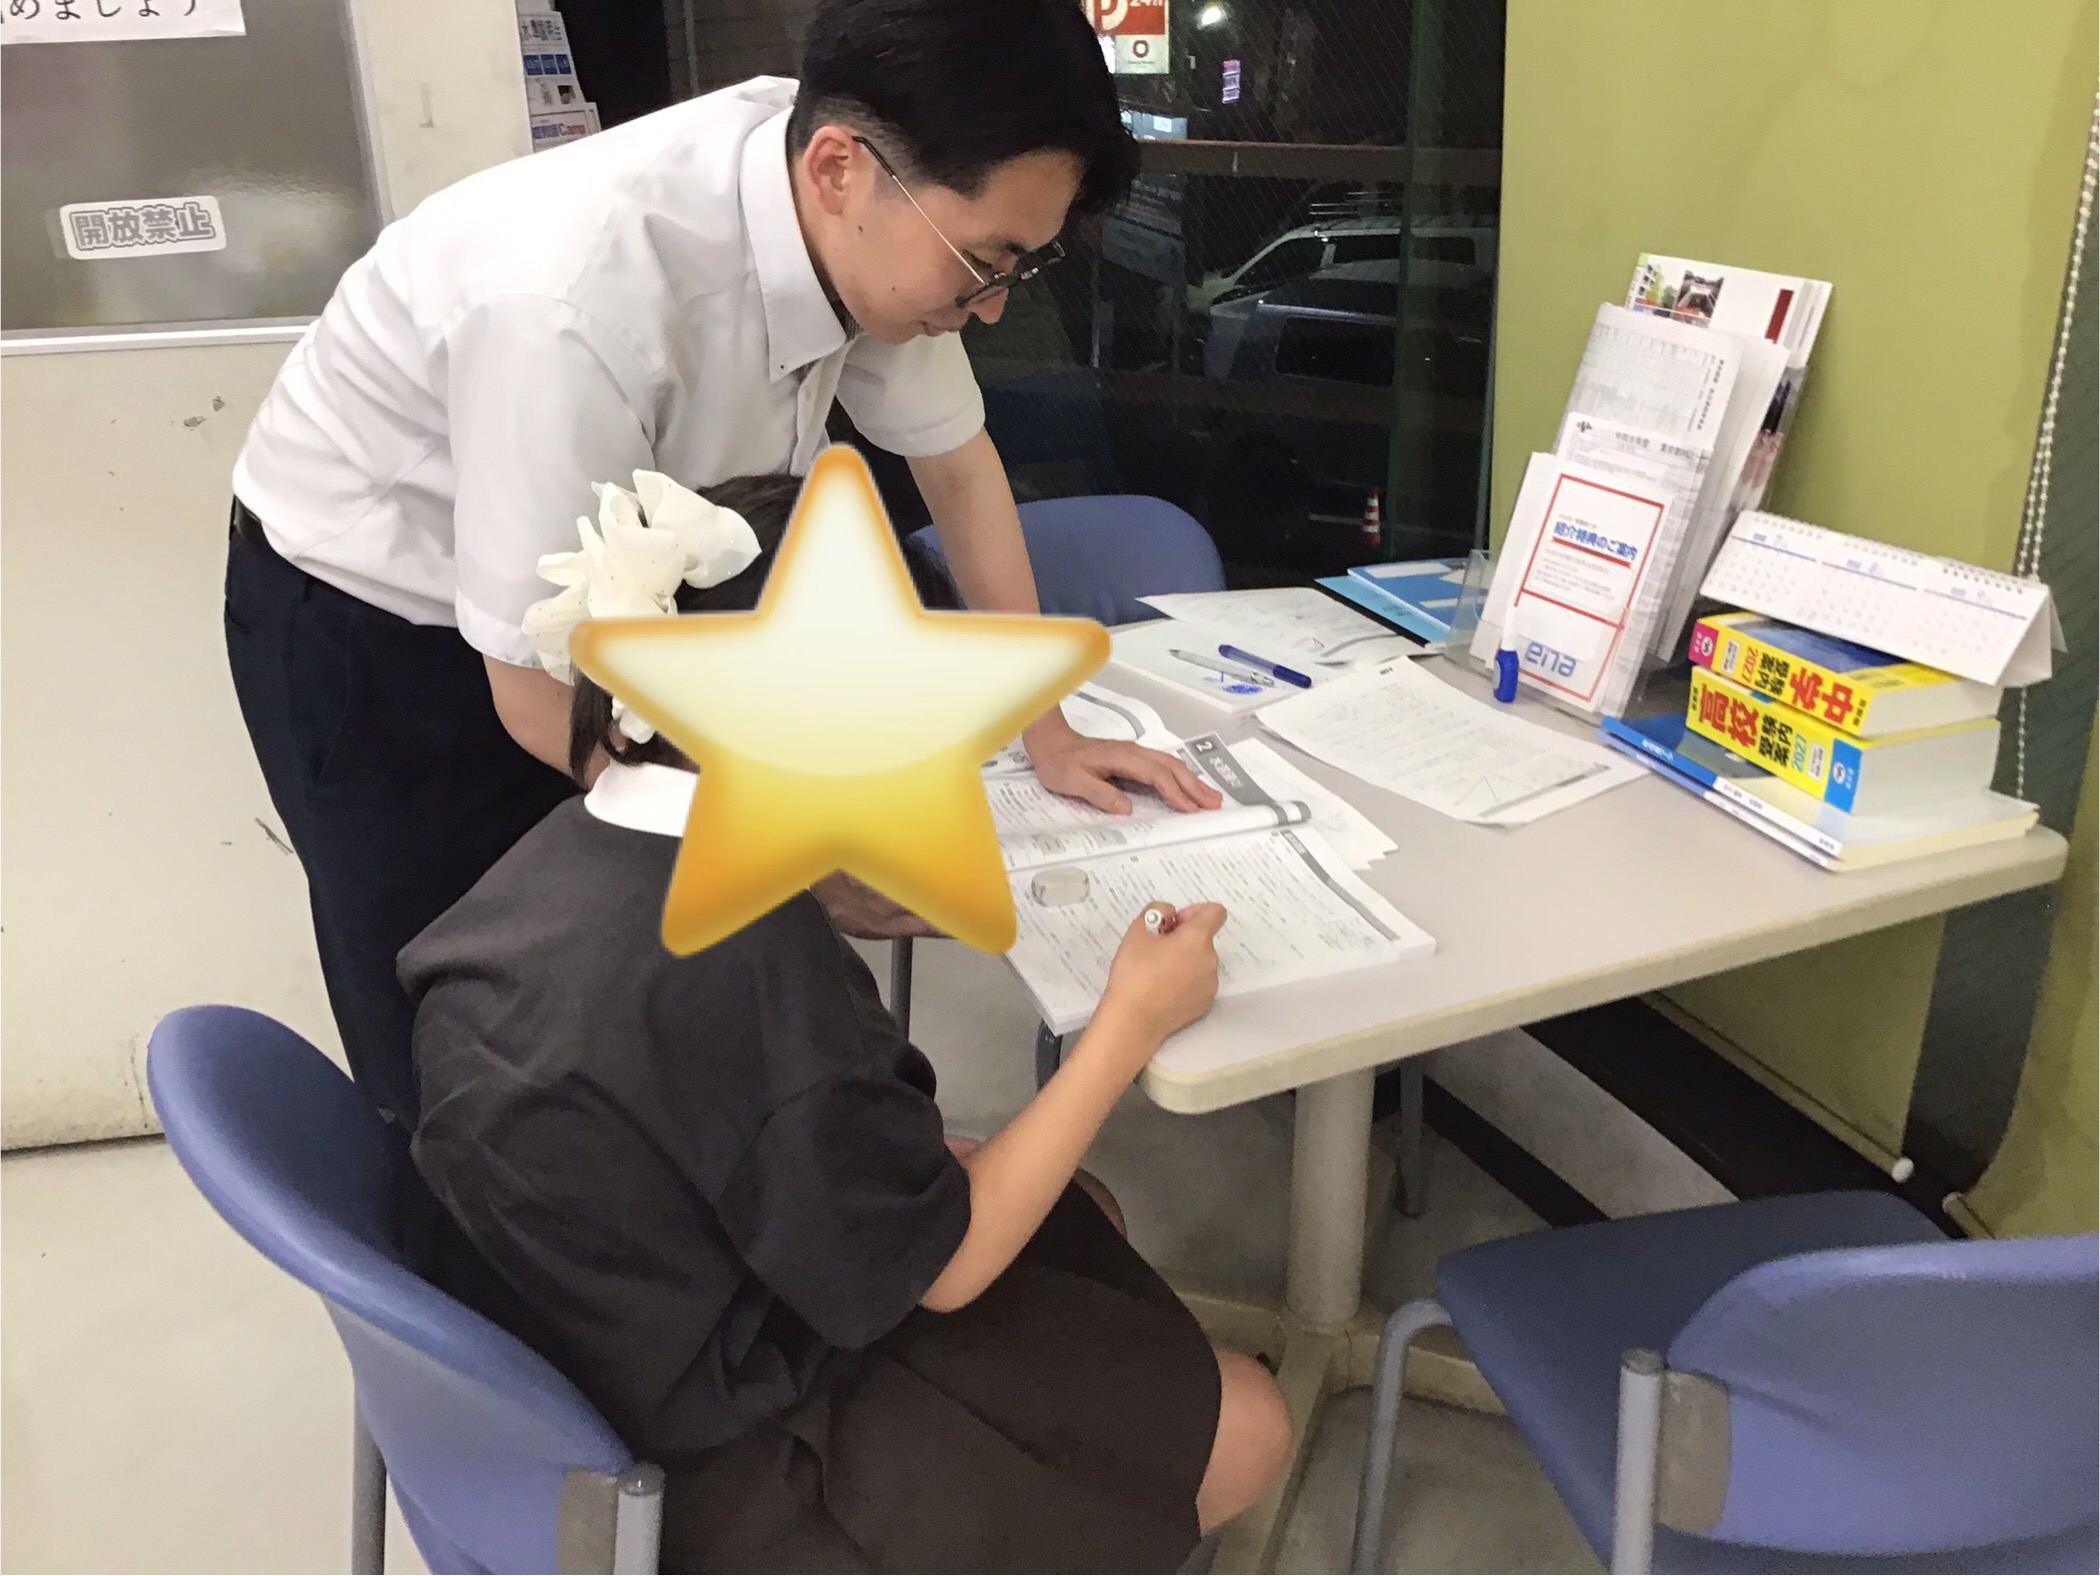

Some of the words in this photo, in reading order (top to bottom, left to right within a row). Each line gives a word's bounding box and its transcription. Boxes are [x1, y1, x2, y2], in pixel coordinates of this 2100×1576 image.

[70, 202, 216, 251] 開放禁止
[1552, 521, 1638, 561] 紹介特典のご案内
[1524, 640, 1577, 678] ena
[1742, 646, 1758, 683] 2027
[1698, 683, 1759, 747] 高校
[1789, 667, 1854, 725] 中学
[1196, 741, 1213, 752] 2
[1791, 733, 1807, 772] 2027
